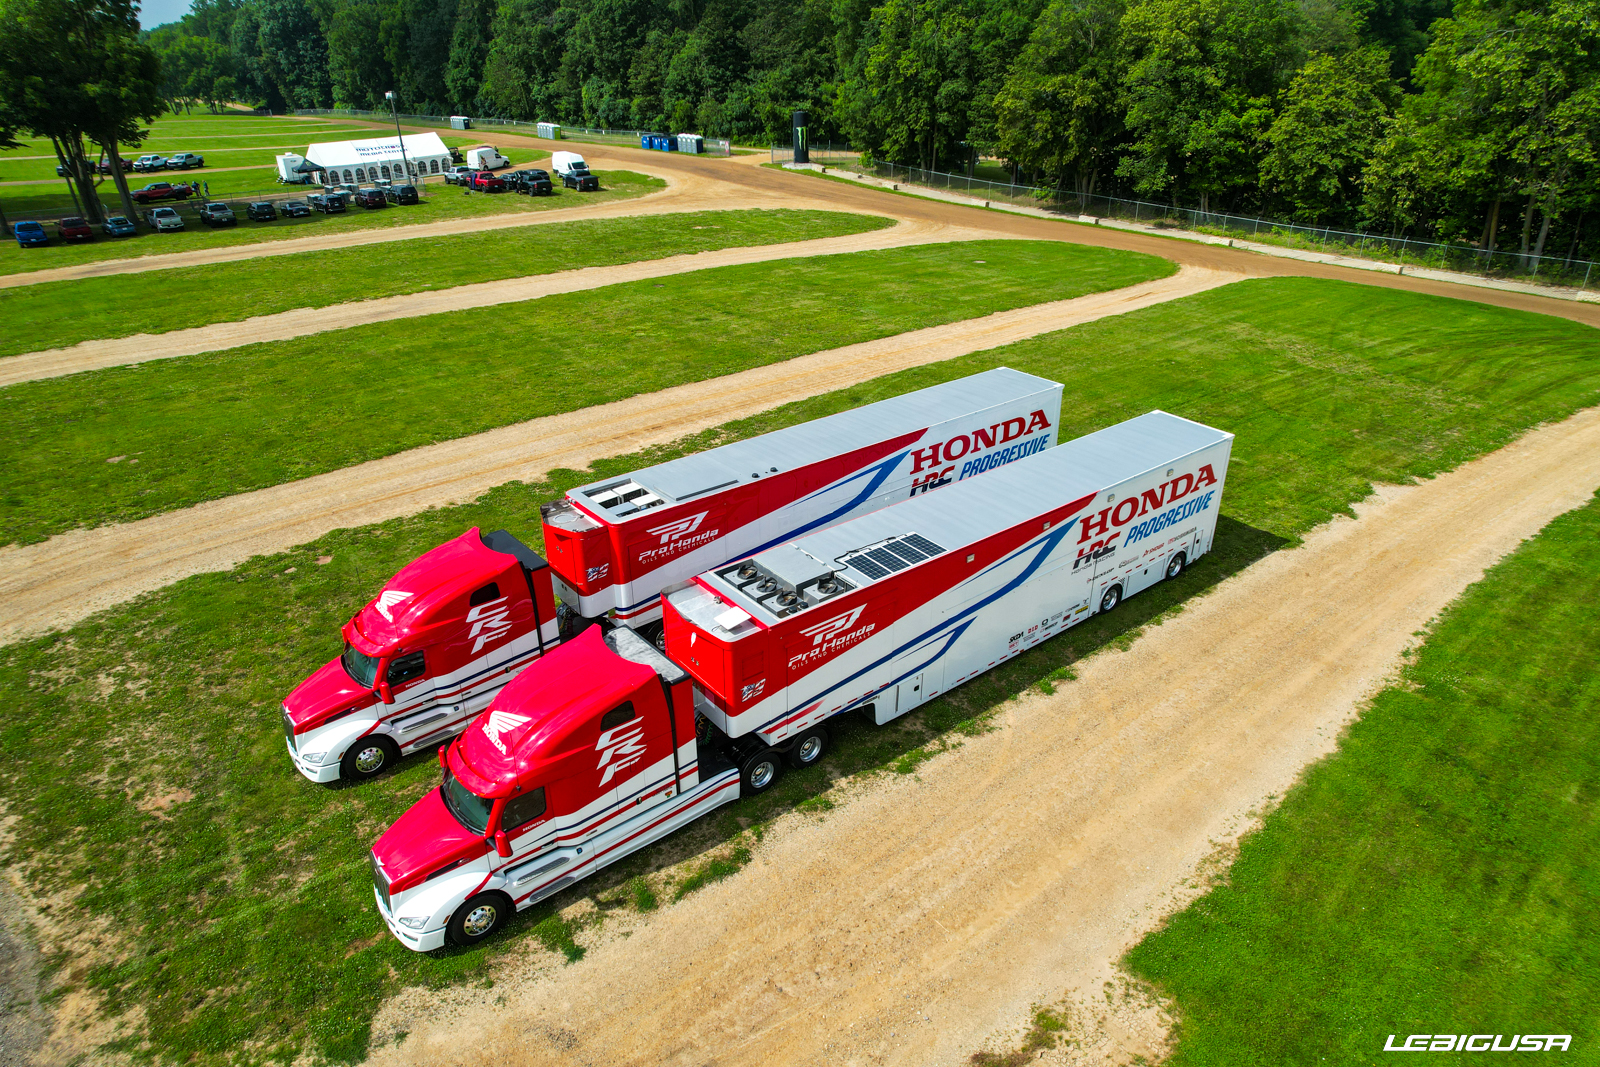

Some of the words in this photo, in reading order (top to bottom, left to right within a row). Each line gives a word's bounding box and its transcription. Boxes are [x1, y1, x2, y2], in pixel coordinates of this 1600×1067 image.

[909, 409, 1052, 476] HONDA
[959, 434, 1051, 481] PROGRESSIVE
[909, 465, 956, 497] HRC
[1076, 463, 1218, 546] HONDA
[1123, 490, 1216, 548] PROGRESSIVE
[642, 555, 658, 564] OILS
[661, 550, 675, 558] AND
[678, 536, 716, 552] CHEMICALS
[669, 528, 719, 551] Honda
[1072, 531, 1121, 570] HRC
[465, 596, 513, 655] CRF
[821, 623, 876, 652] Honda
[791, 659, 809, 670] OILS
[812, 651, 828, 661] AND
[831, 632, 871, 652] CHEMICALS
[405, 678, 426, 689] HONDA
[481, 723, 507, 755] HONDA
[594, 715, 648, 788] CRF
[522, 819, 546, 832] HONDA
